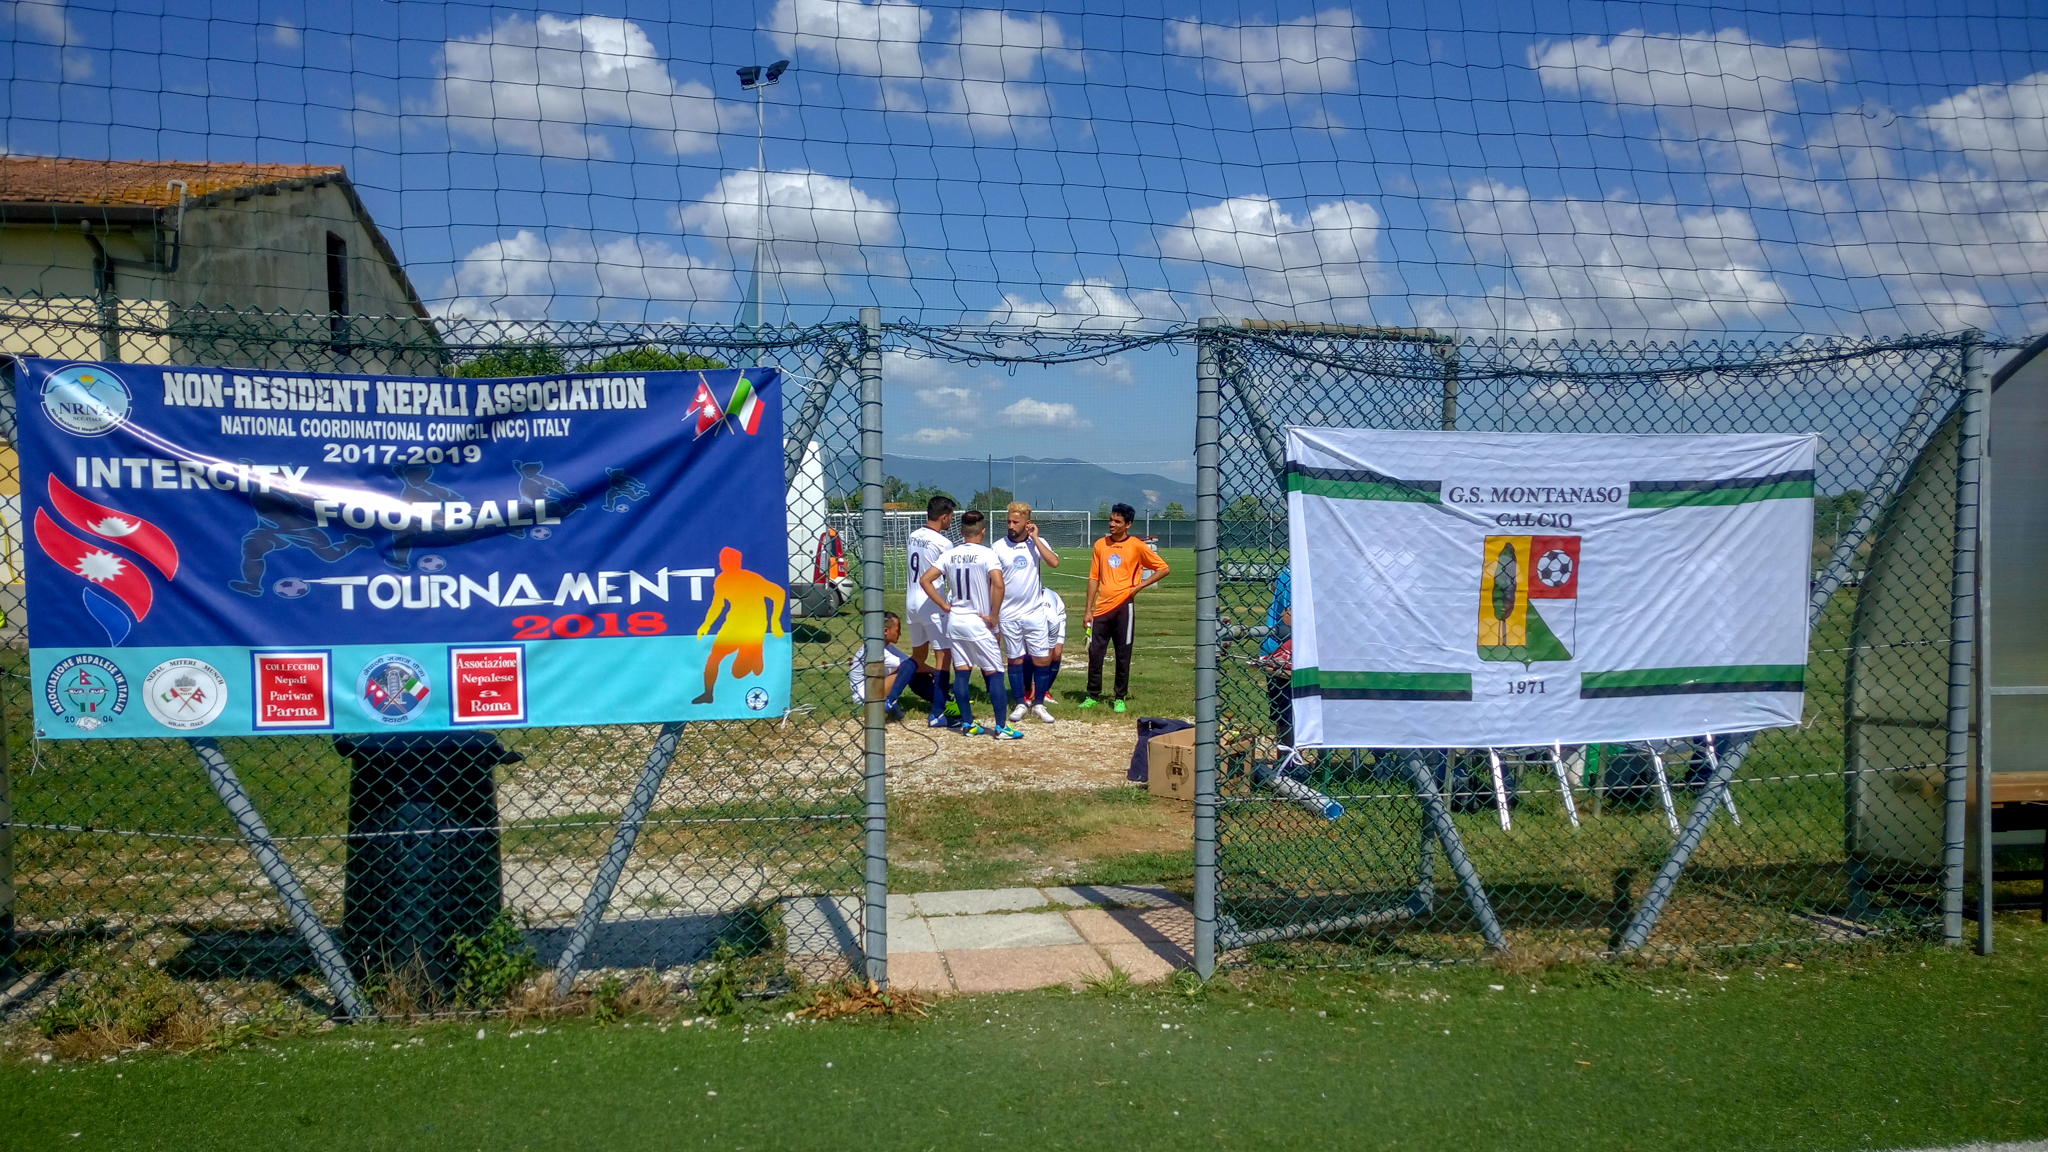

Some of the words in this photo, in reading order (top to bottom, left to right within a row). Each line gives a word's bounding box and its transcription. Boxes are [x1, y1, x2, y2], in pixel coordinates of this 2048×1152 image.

[163, 372, 370, 414] NON-RESIDENT
[376, 381, 469, 417] NEPALI
[474, 377, 647, 417] ASSOCIATION
[58, 402, 114, 418] NRNA
[221, 415, 297, 437] NATIONAL
[300, 418, 424, 441] COORDINATIONAL
[427, 422, 488, 443] COUNCIL
[491, 418, 530, 443] (NCC)
[533, 418, 571, 438] ITALY
[323, 443, 482, 465] 2017-2019
[76, 456, 310, 494] INTERCITY
[1448, 486, 1485, 504] G.S.
[1490, 486, 1622, 504] MONTANASO
[314, 498, 562, 532] FOOTBALL
[1495, 512, 1573, 529] CALCIO
[910, 551, 920, 584] 9
[956, 568, 971, 600] 11
[512, 610, 668, 640] 2018
[75, 655, 118, 675] NEPALESE
[265, 663, 320, 671] COLLECCHIO
[457, 656, 517, 670] Associazione
[114, 673, 125, 684] IN
[146, 666, 166, 683] NEPAL
[203, 665, 225, 686] MUNCH
[274, 675, 308, 687] Nepali
[462, 672, 515, 686] Nepalese
[47, 658, 75, 714] ASSOCIAZIONE
[479, 689, 501, 698] a
[1507, 680, 1546, 695] 1971
[113, 684, 128, 713] ITALIA
[270, 690, 314, 701] Pariwar
[266, 704, 319, 717] Parma
[470, 699, 512, 713] Roma
[64, 715, 75, 723] 20
[102, 715, 113, 723] 04
